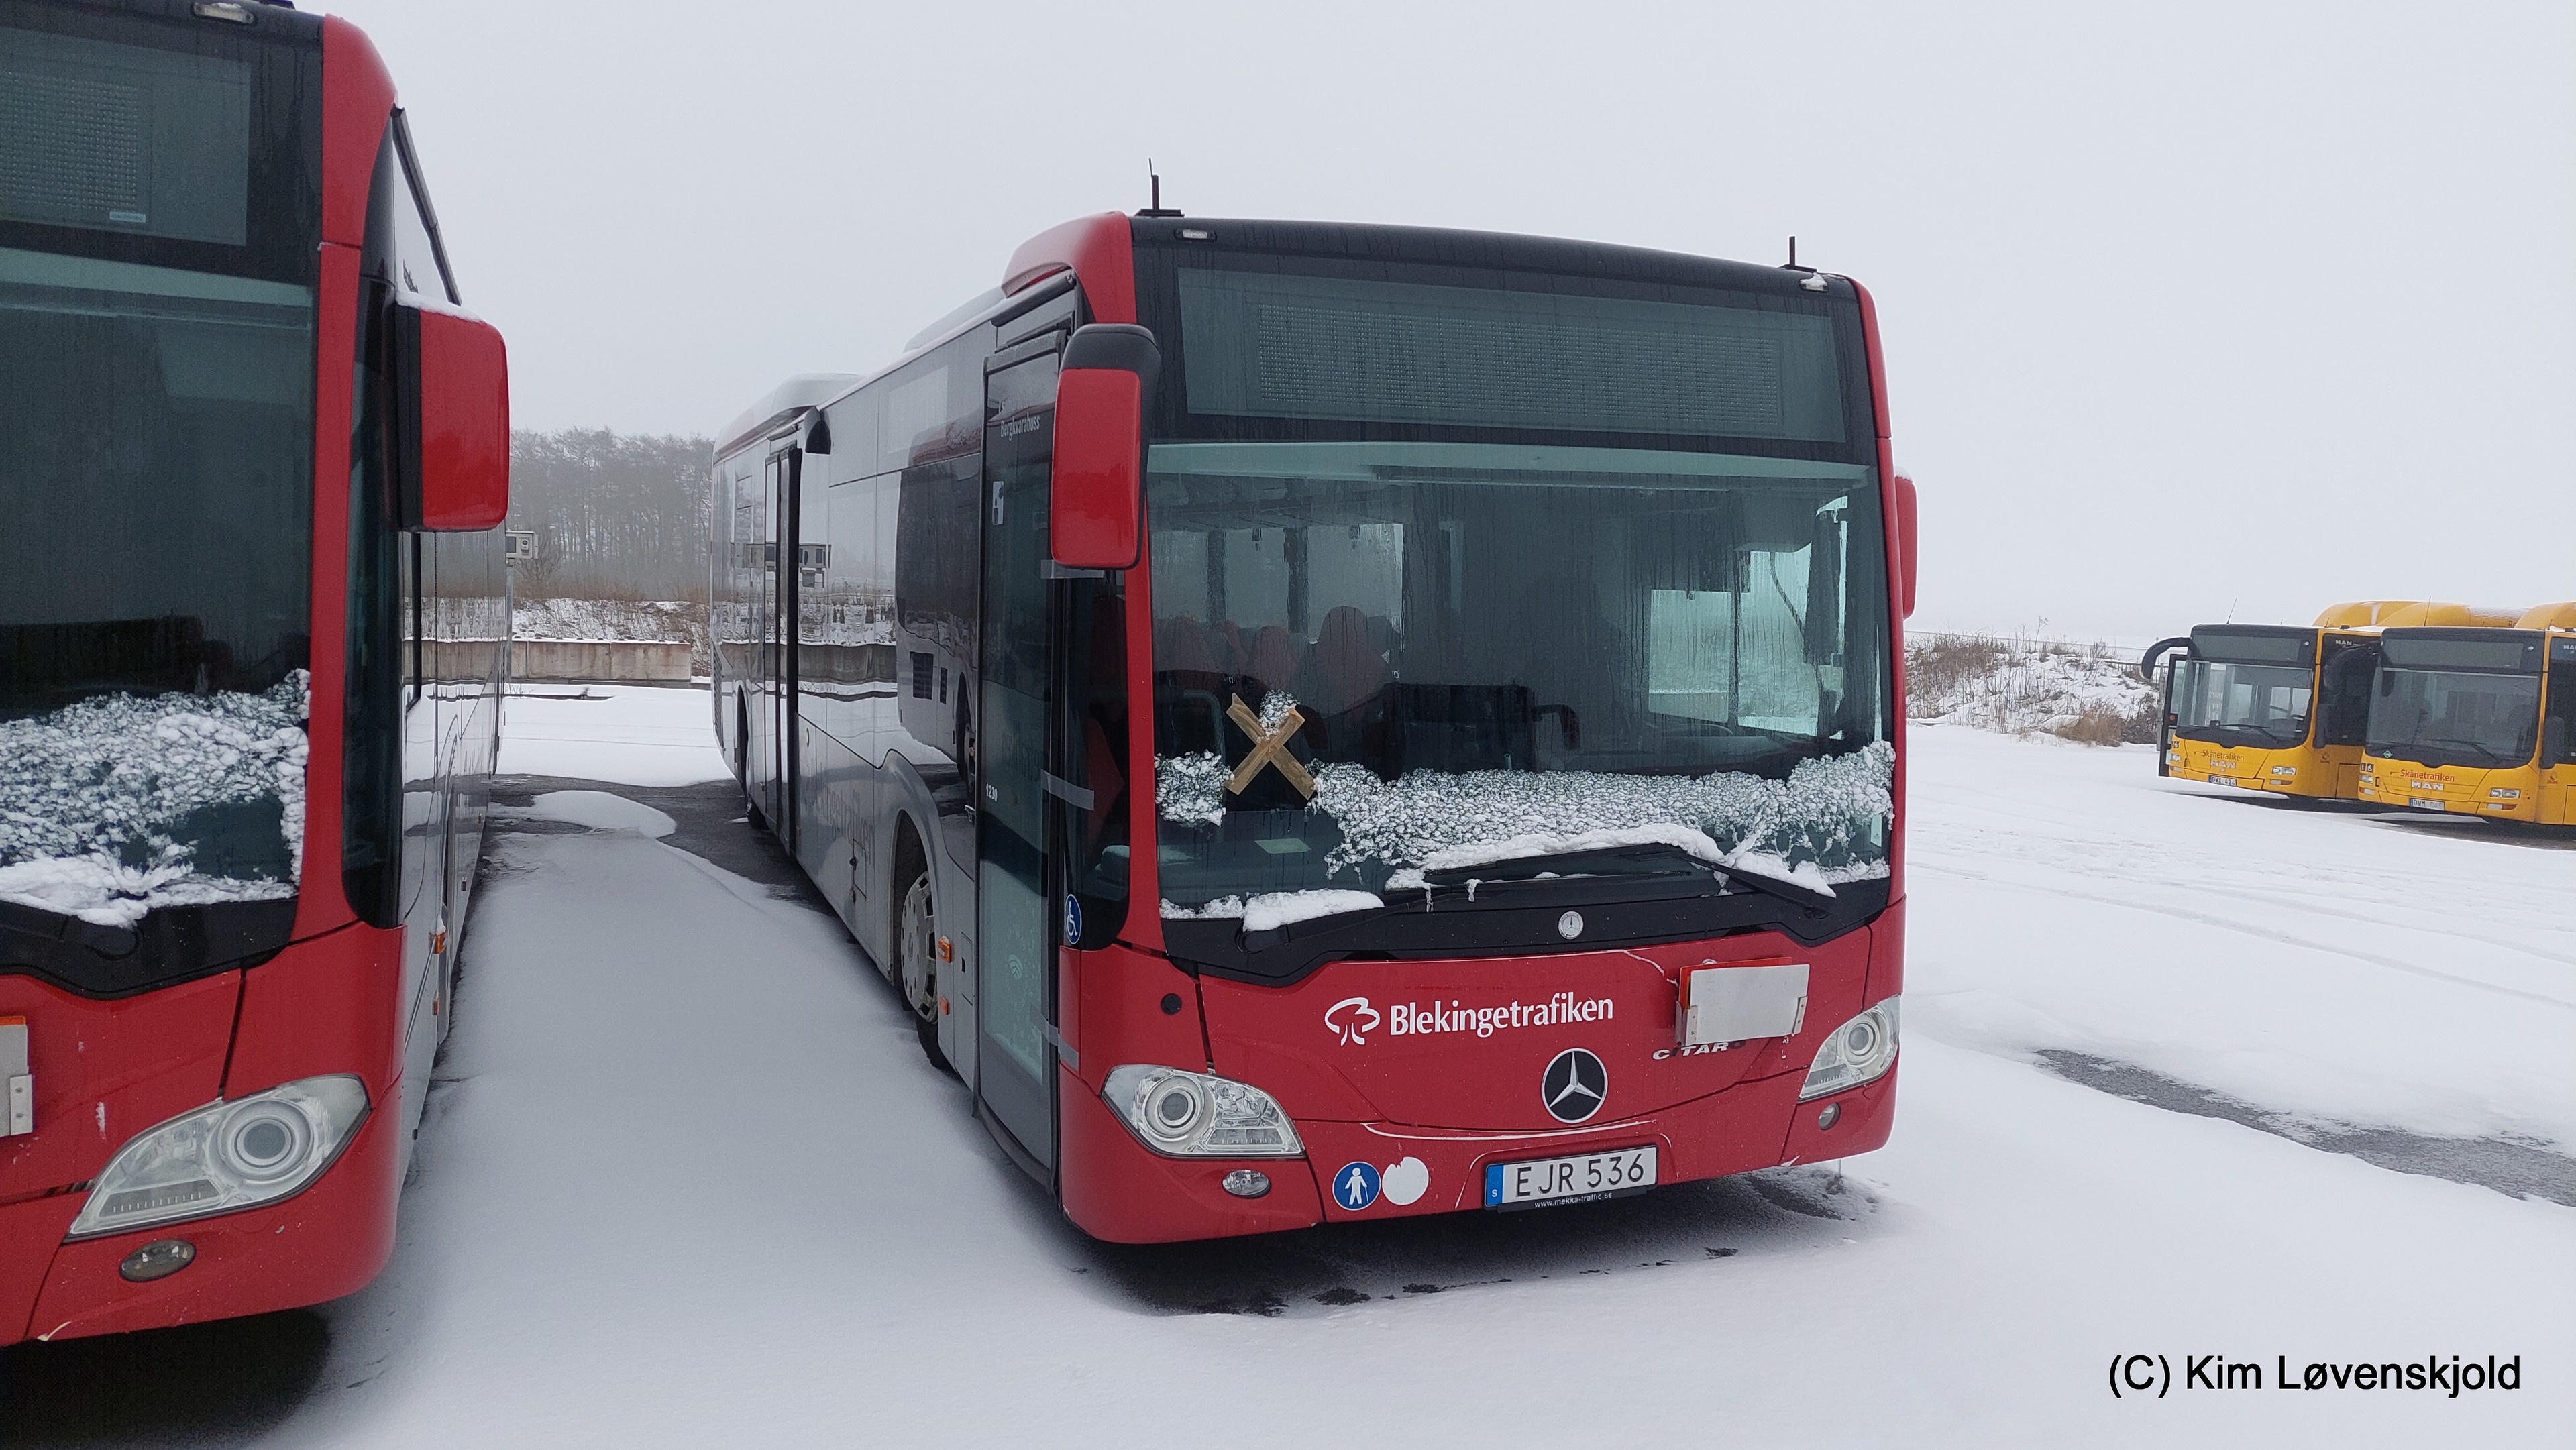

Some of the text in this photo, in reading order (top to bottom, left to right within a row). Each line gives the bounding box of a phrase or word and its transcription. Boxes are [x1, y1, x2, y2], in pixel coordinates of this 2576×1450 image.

[1000, 412, 1040, 441] Bergkvarabuss
[2202, 749, 2245, 762] Skånetrafiken
[2210, 760, 2237, 769] MAN
[2400, 769, 2455, 783] Skånetrafiken
[985, 783, 998, 802] 1230
[2411, 781, 2445, 791] MAN
[1391, 991, 1614, 1038] Blekingetrafiken
[1516, 1153, 1644, 1198] EJR 536
[1491, 1189, 1498, 1198] S
[1534, 1192, 1612, 1208] www.mekka-traffic.se
